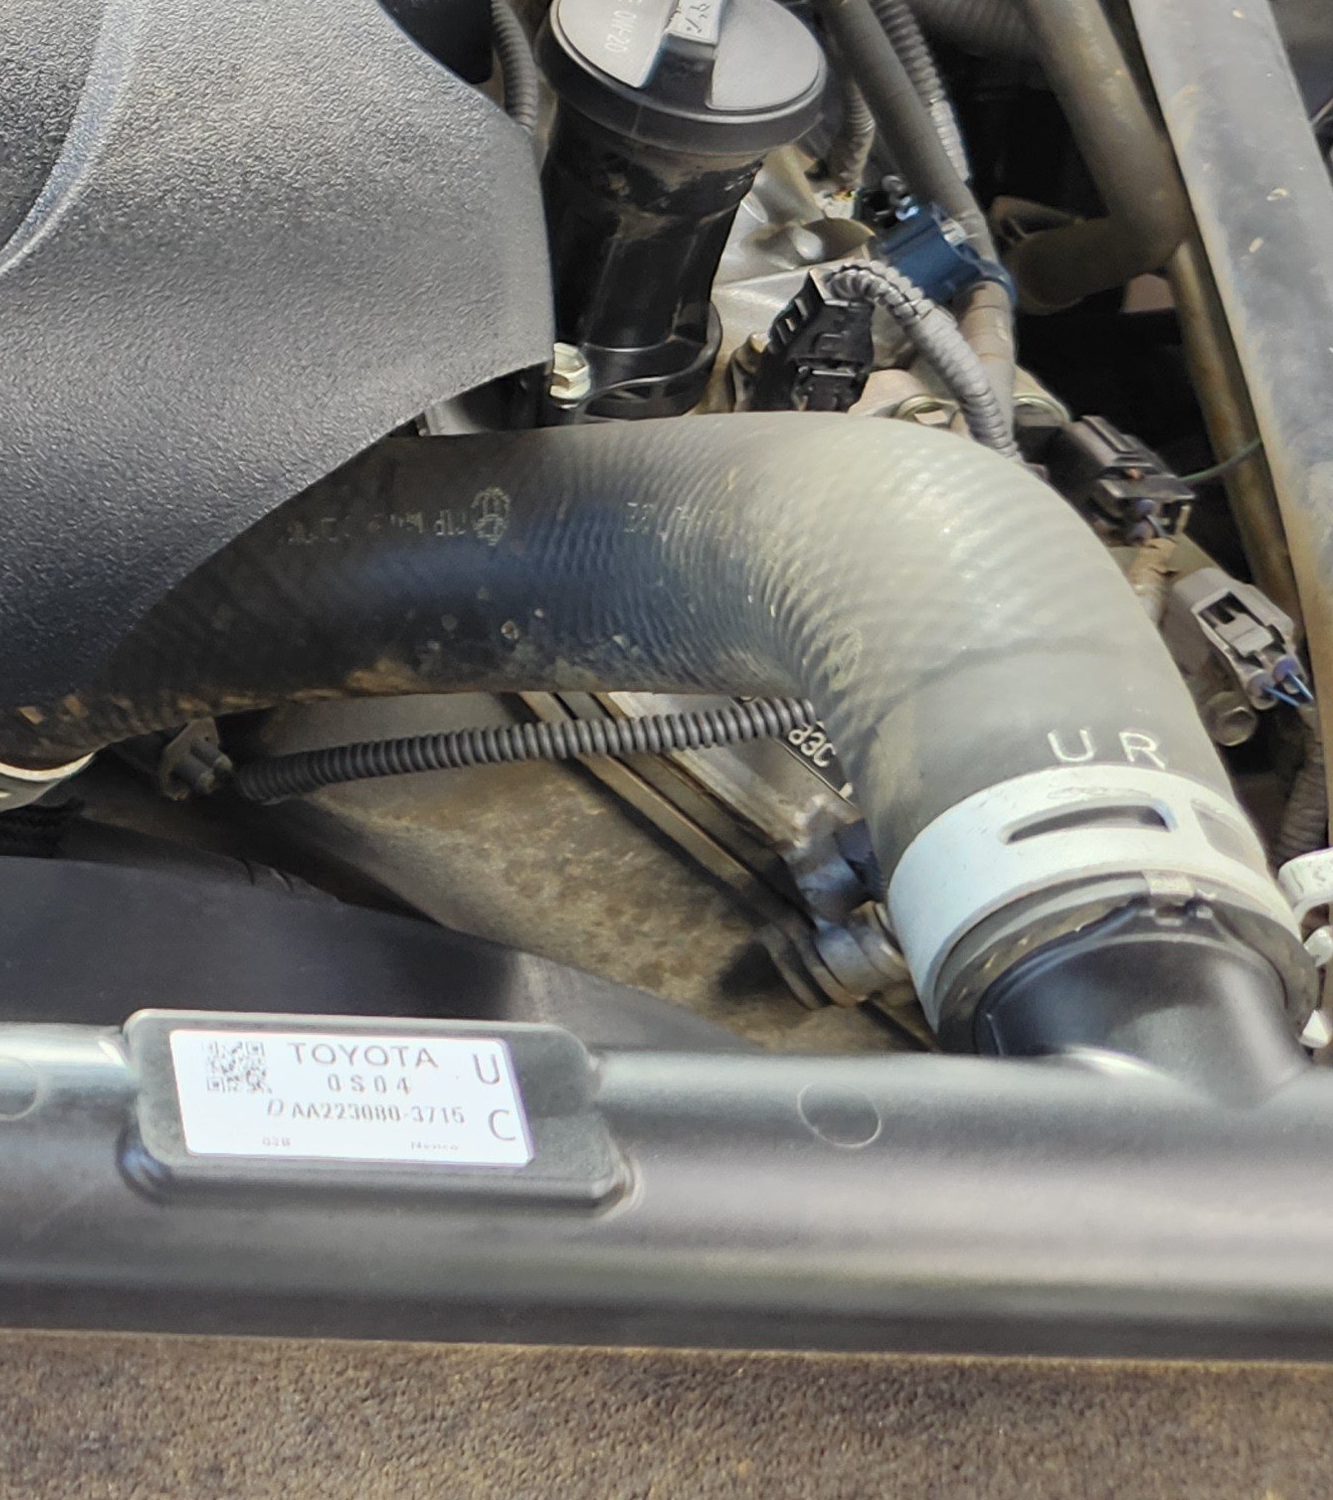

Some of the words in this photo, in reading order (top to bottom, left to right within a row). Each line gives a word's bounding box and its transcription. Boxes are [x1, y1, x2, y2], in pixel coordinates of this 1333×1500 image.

[603, 9, 638, 53] 0W-20
[288, 1042, 439, 1068] TOYOTA
[473, 1053, 502, 1085] U
[487, 1109, 517, 1142] C
